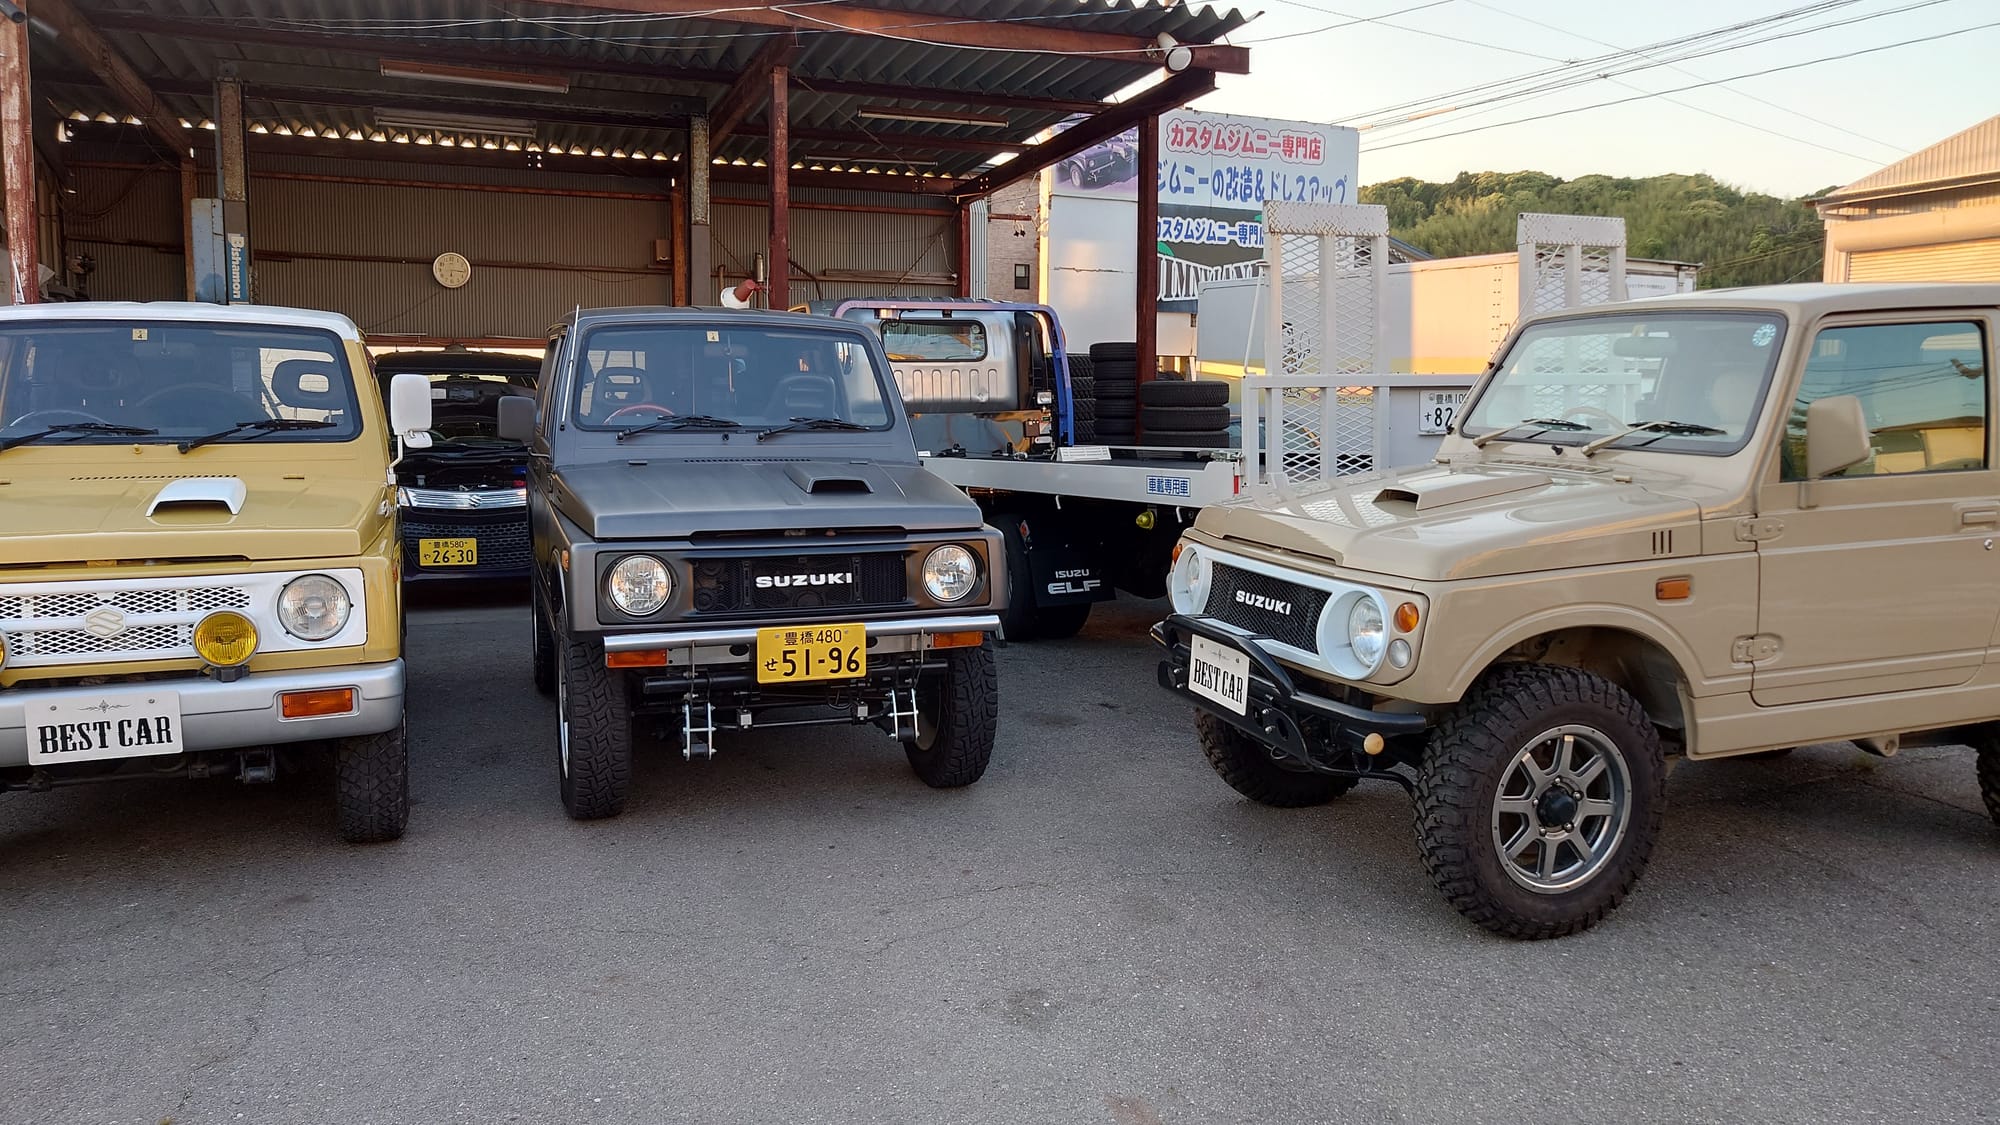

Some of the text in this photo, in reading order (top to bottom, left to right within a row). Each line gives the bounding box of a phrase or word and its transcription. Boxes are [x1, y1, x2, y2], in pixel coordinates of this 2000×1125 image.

[1171, 124, 1321, 160] カスタムジムニー専門店
[1148, 477, 1189, 495] 車載専用車
[432, 549, 474, 564] 26-30
[755, 572, 853, 588] SUZUKI
[1055, 568, 1090, 579] ISUZU
[1047, 579, 1101, 595] ELF
[1235, 589, 1292, 616] SUZUKI
[782, 645, 860, 677] 51-96
[1193, 658, 1243, 704] BEST CAR
[37, 716, 173, 754] BEST CAR
